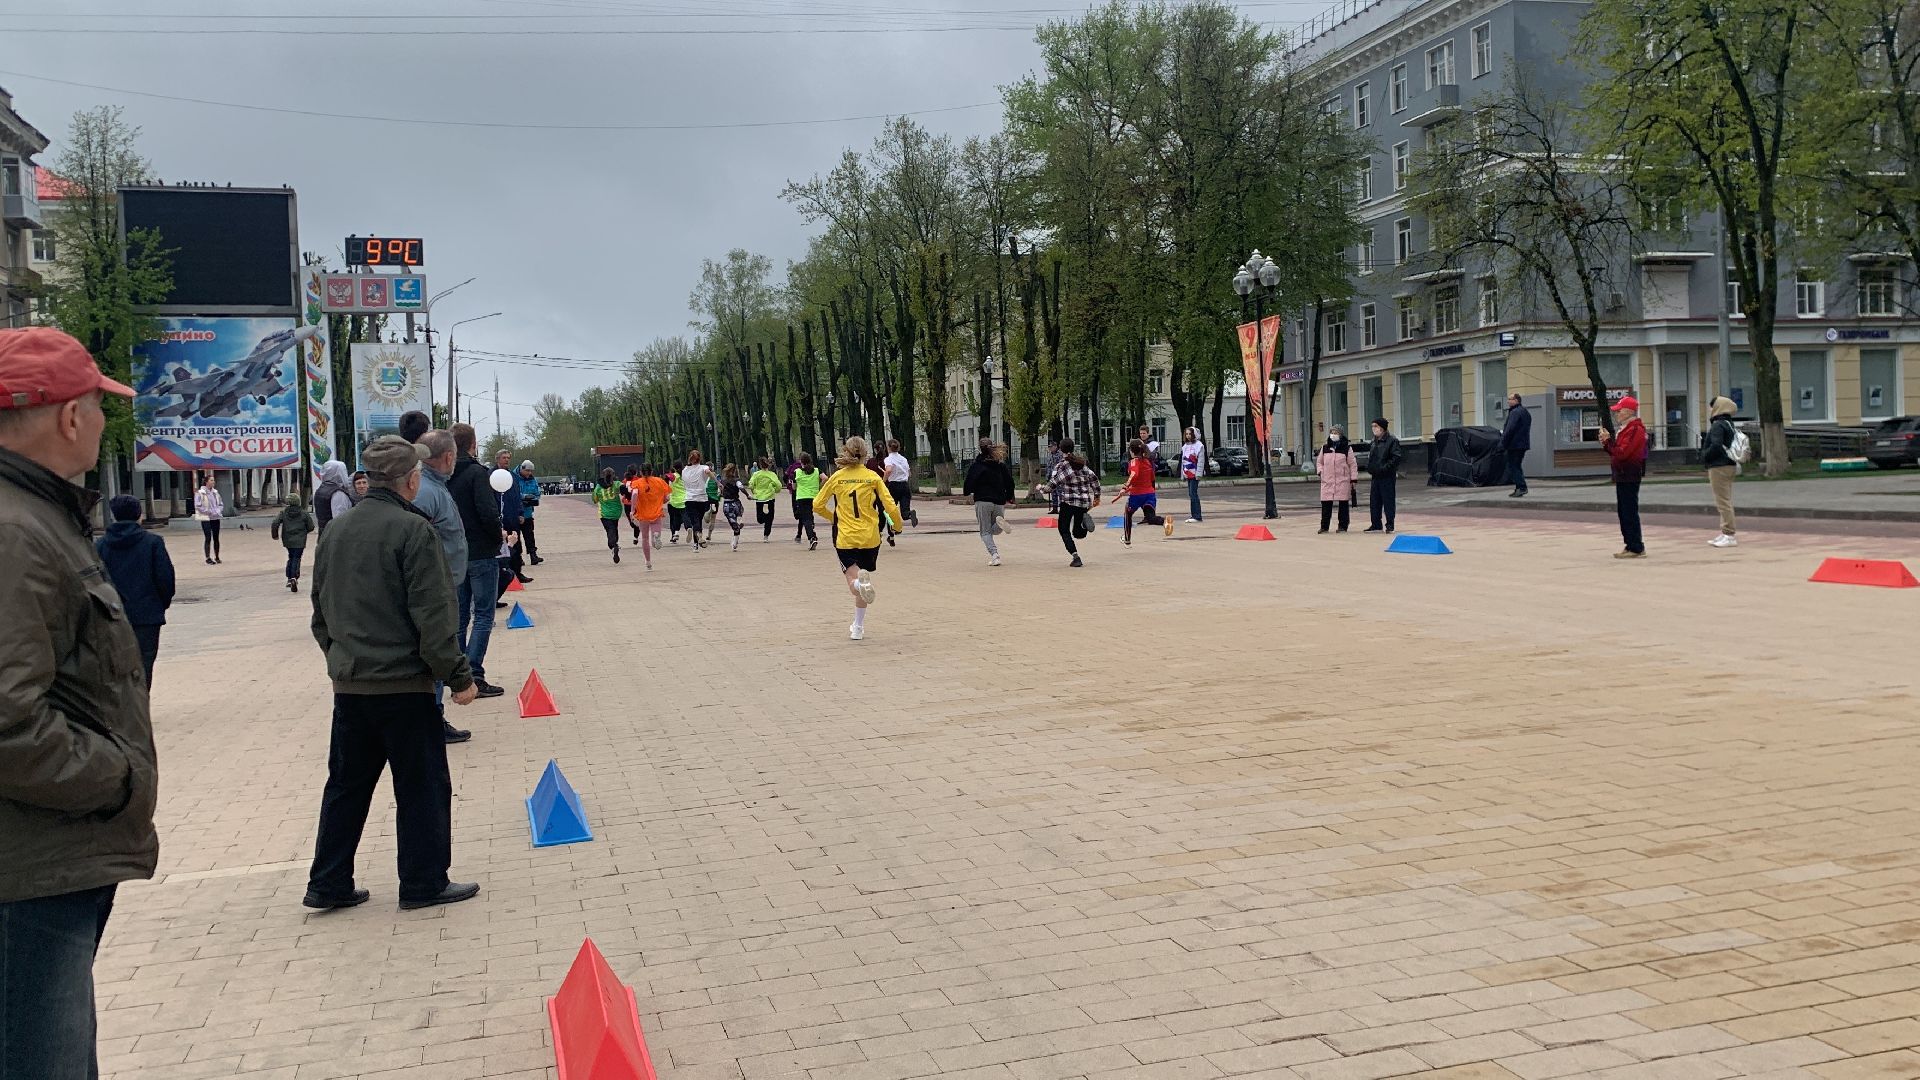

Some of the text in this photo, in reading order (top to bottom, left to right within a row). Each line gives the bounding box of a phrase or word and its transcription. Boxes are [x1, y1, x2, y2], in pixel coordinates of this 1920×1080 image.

[1563, 389, 1629, 400] МОРОЕНОЕ
[188, 425, 293, 438] авиастроения
[193, 438, 294, 454] РОССИИ
[848, 489, 860, 519] 1
